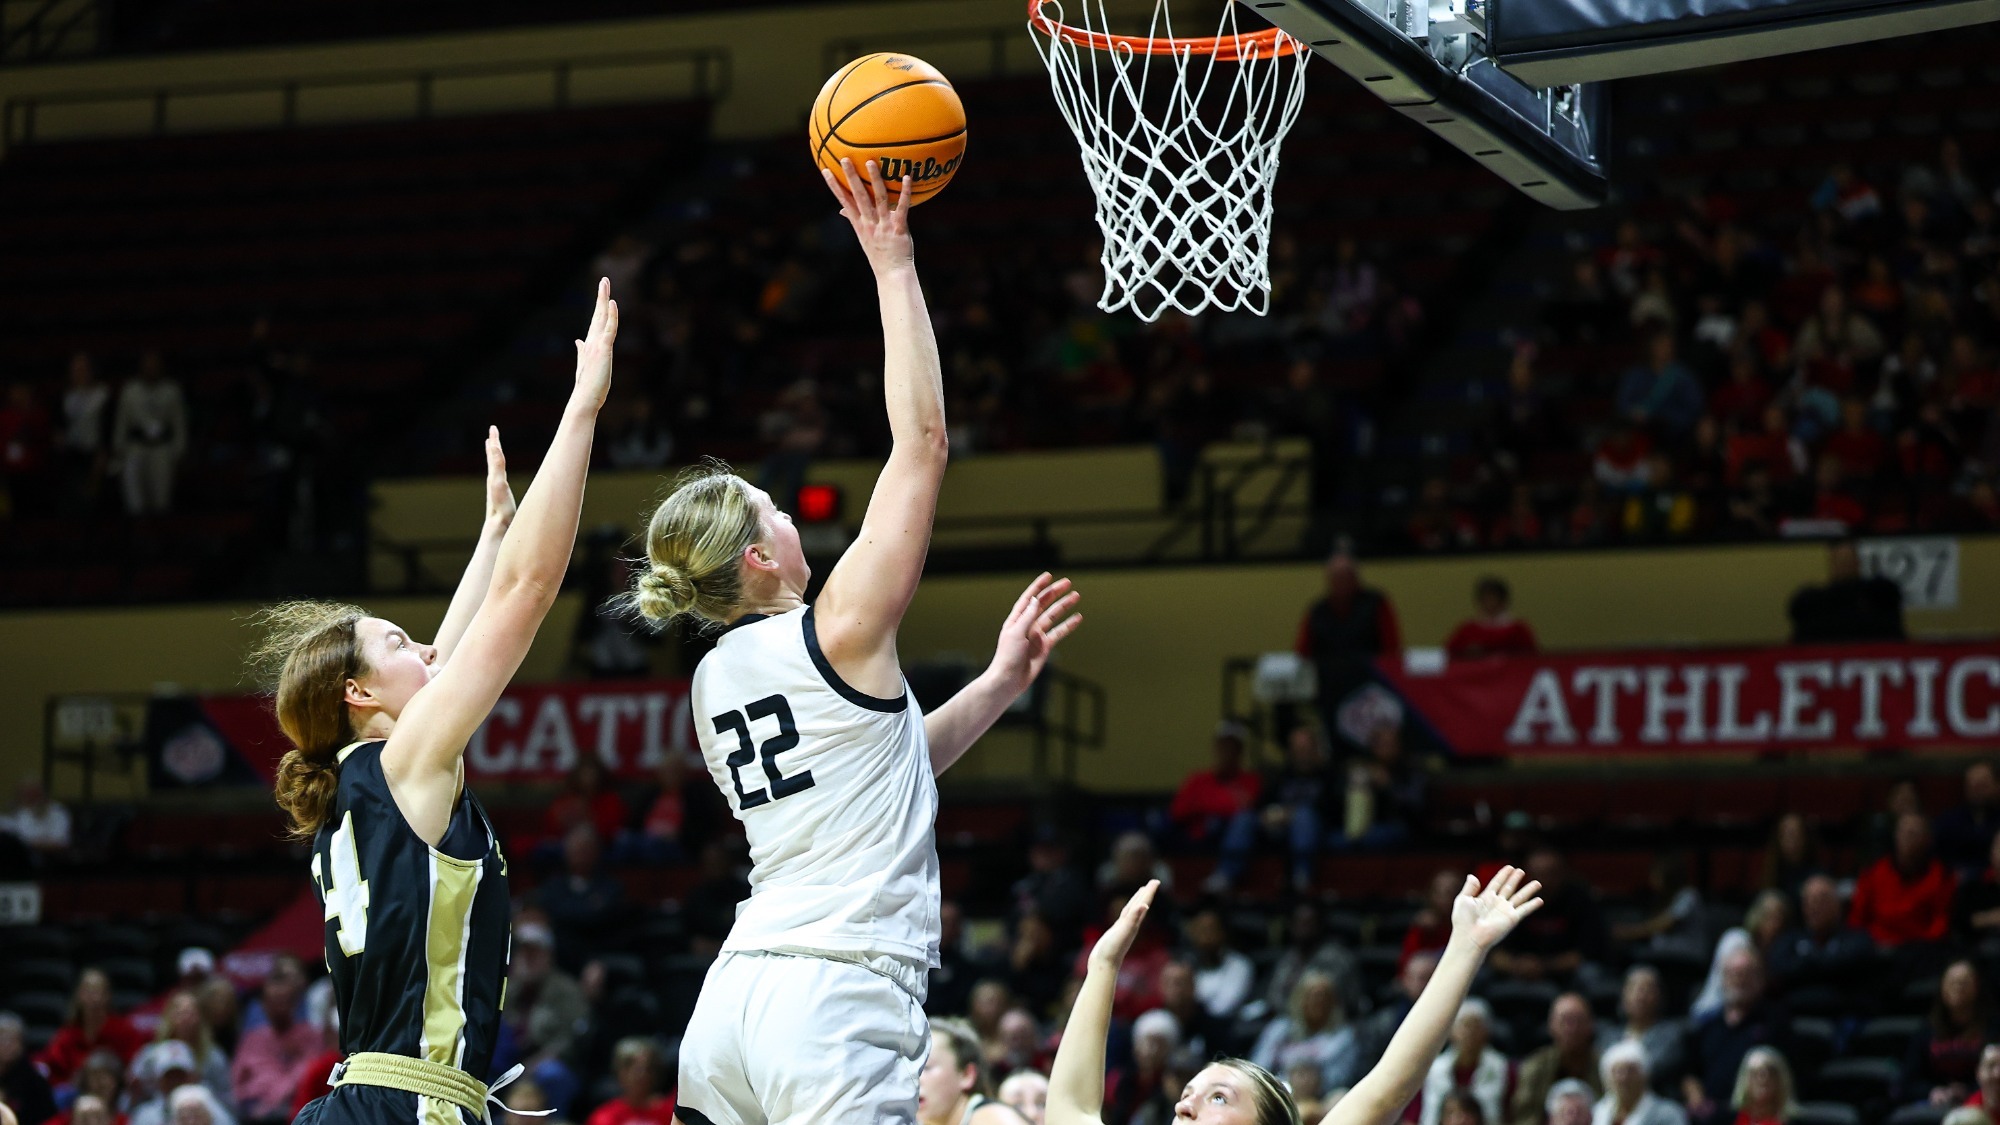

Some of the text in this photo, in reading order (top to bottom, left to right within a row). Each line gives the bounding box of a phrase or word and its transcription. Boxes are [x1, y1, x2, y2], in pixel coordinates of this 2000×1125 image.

[880, 151, 963, 182] Wilson
[1506, 655, 2000, 745] ATHLETIC
[711, 693, 816, 811] 22
